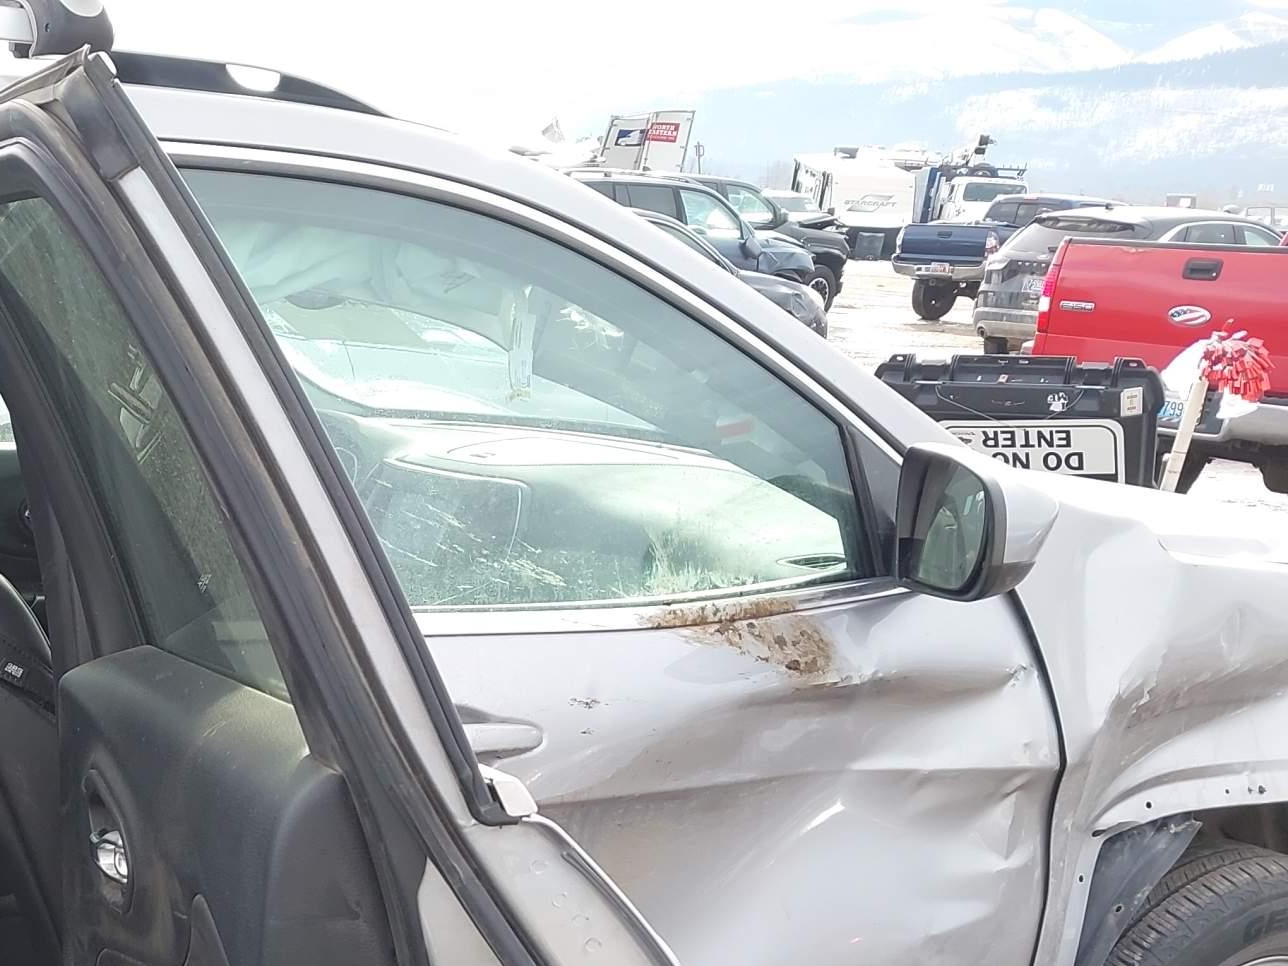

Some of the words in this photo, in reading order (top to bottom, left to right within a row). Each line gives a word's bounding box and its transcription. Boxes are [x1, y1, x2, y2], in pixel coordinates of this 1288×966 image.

[843, 199, 897, 208] STARCRAFT
[981, 429, 1072, 448] ENTER
[1042, 451, 1085, 471] DO
